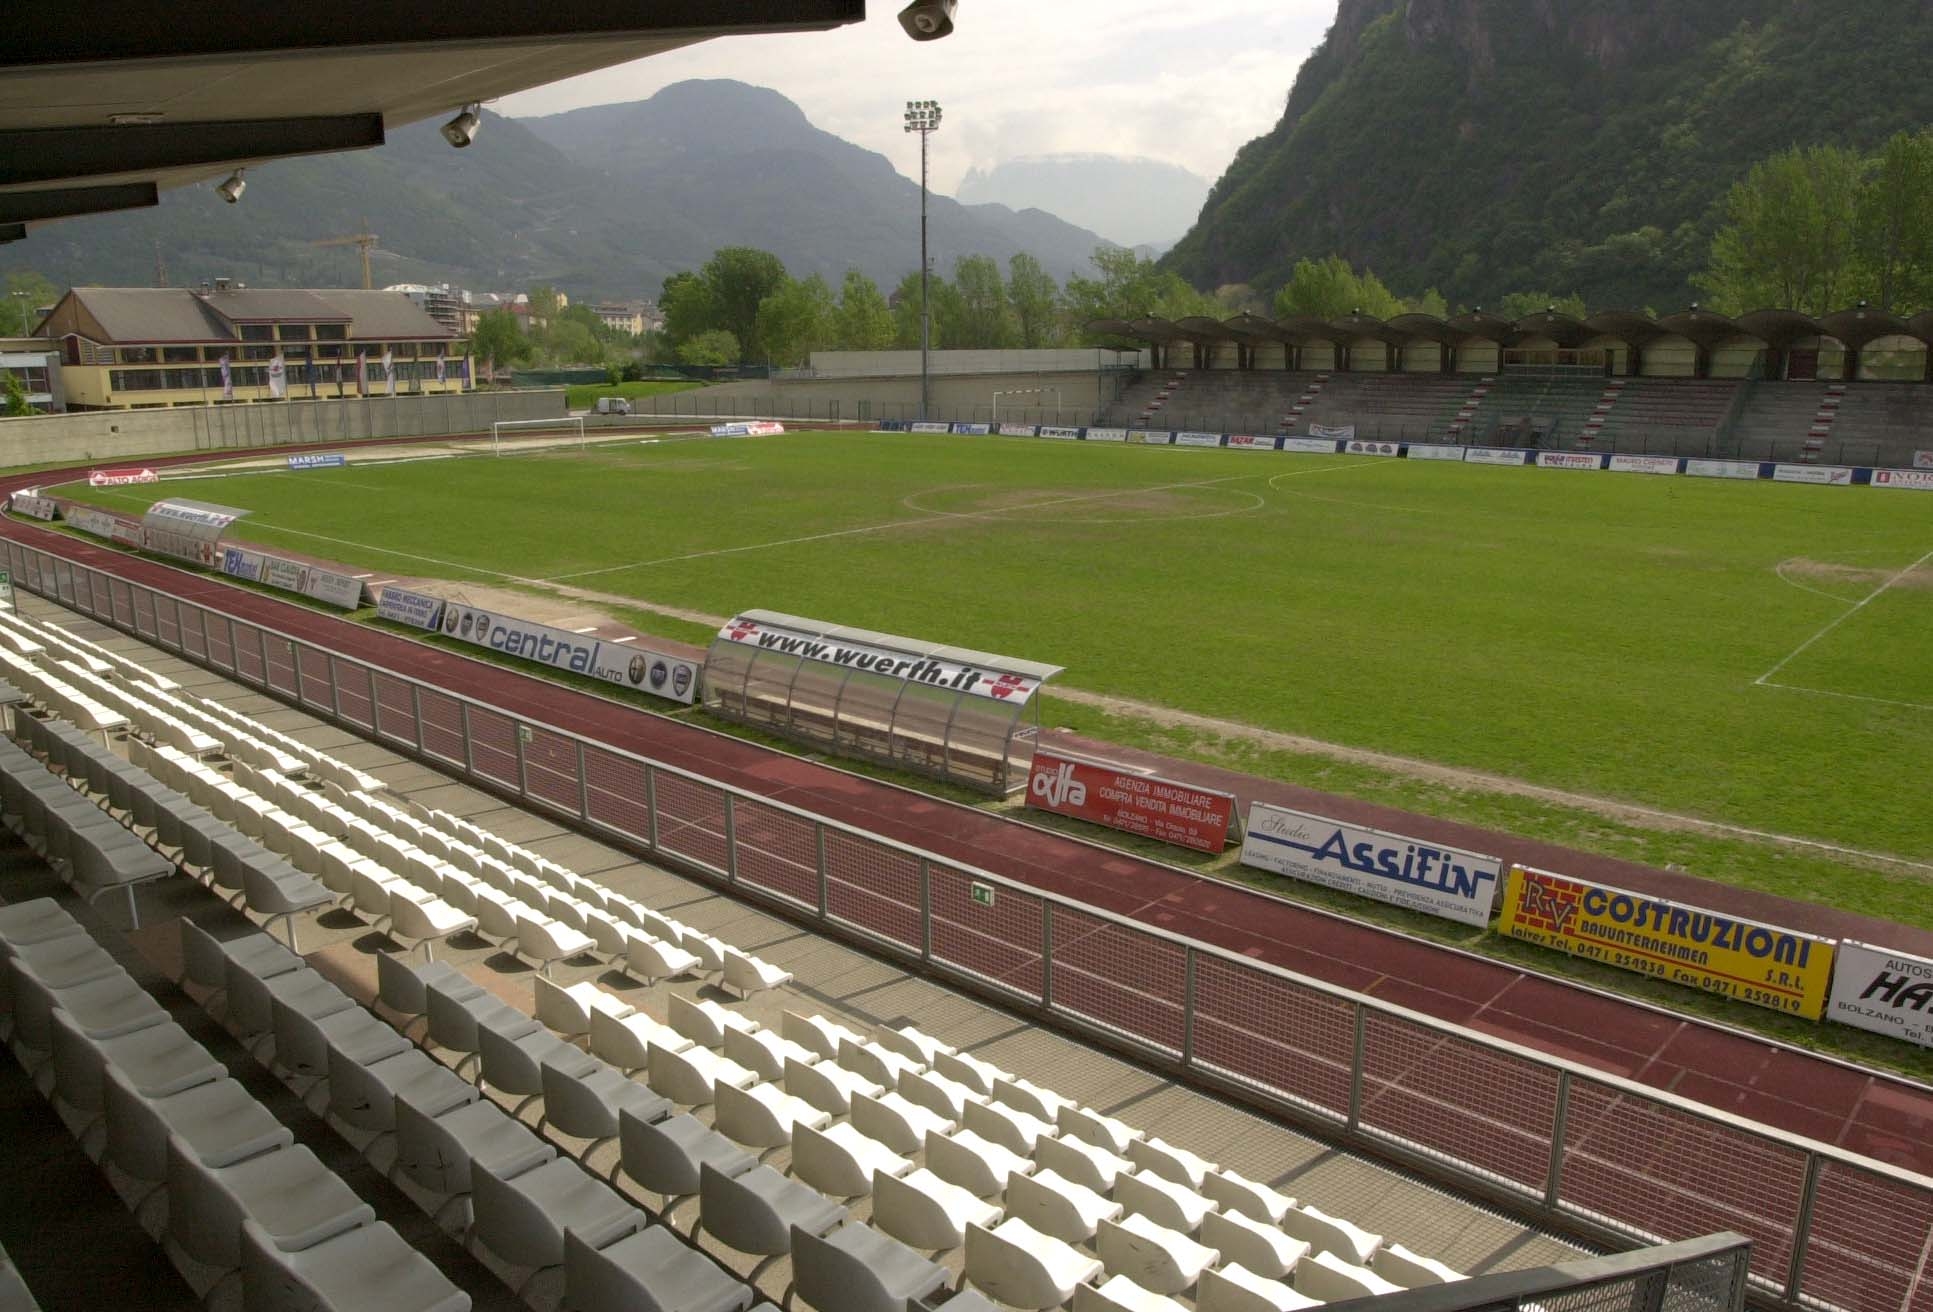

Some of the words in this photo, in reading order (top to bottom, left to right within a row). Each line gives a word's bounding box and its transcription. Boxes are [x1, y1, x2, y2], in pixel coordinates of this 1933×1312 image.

[490, 626, 600, 674] central
[758, 631, 981, 691] www.wuerth.it
[595, 667, 623, 682] AUTO
[1099, 786, 1133, 804] COMPRA
[1135, 796, 1167, 813] VENDITA
[1168, 803, 1223, 827] IMMOBILIARE
[1114, 776, 1150, 795] AGENZIA
[1153, 785, 1213, 809] IMMOBILIARE
[1582, 887, 1811, 969] COSTRUZIONI
[1838, 1001, 1905, 1025] BOLZANO
[1858, 971, 1933, 1015] HA
[1904, 1027, 1926, 1041] Tel.
